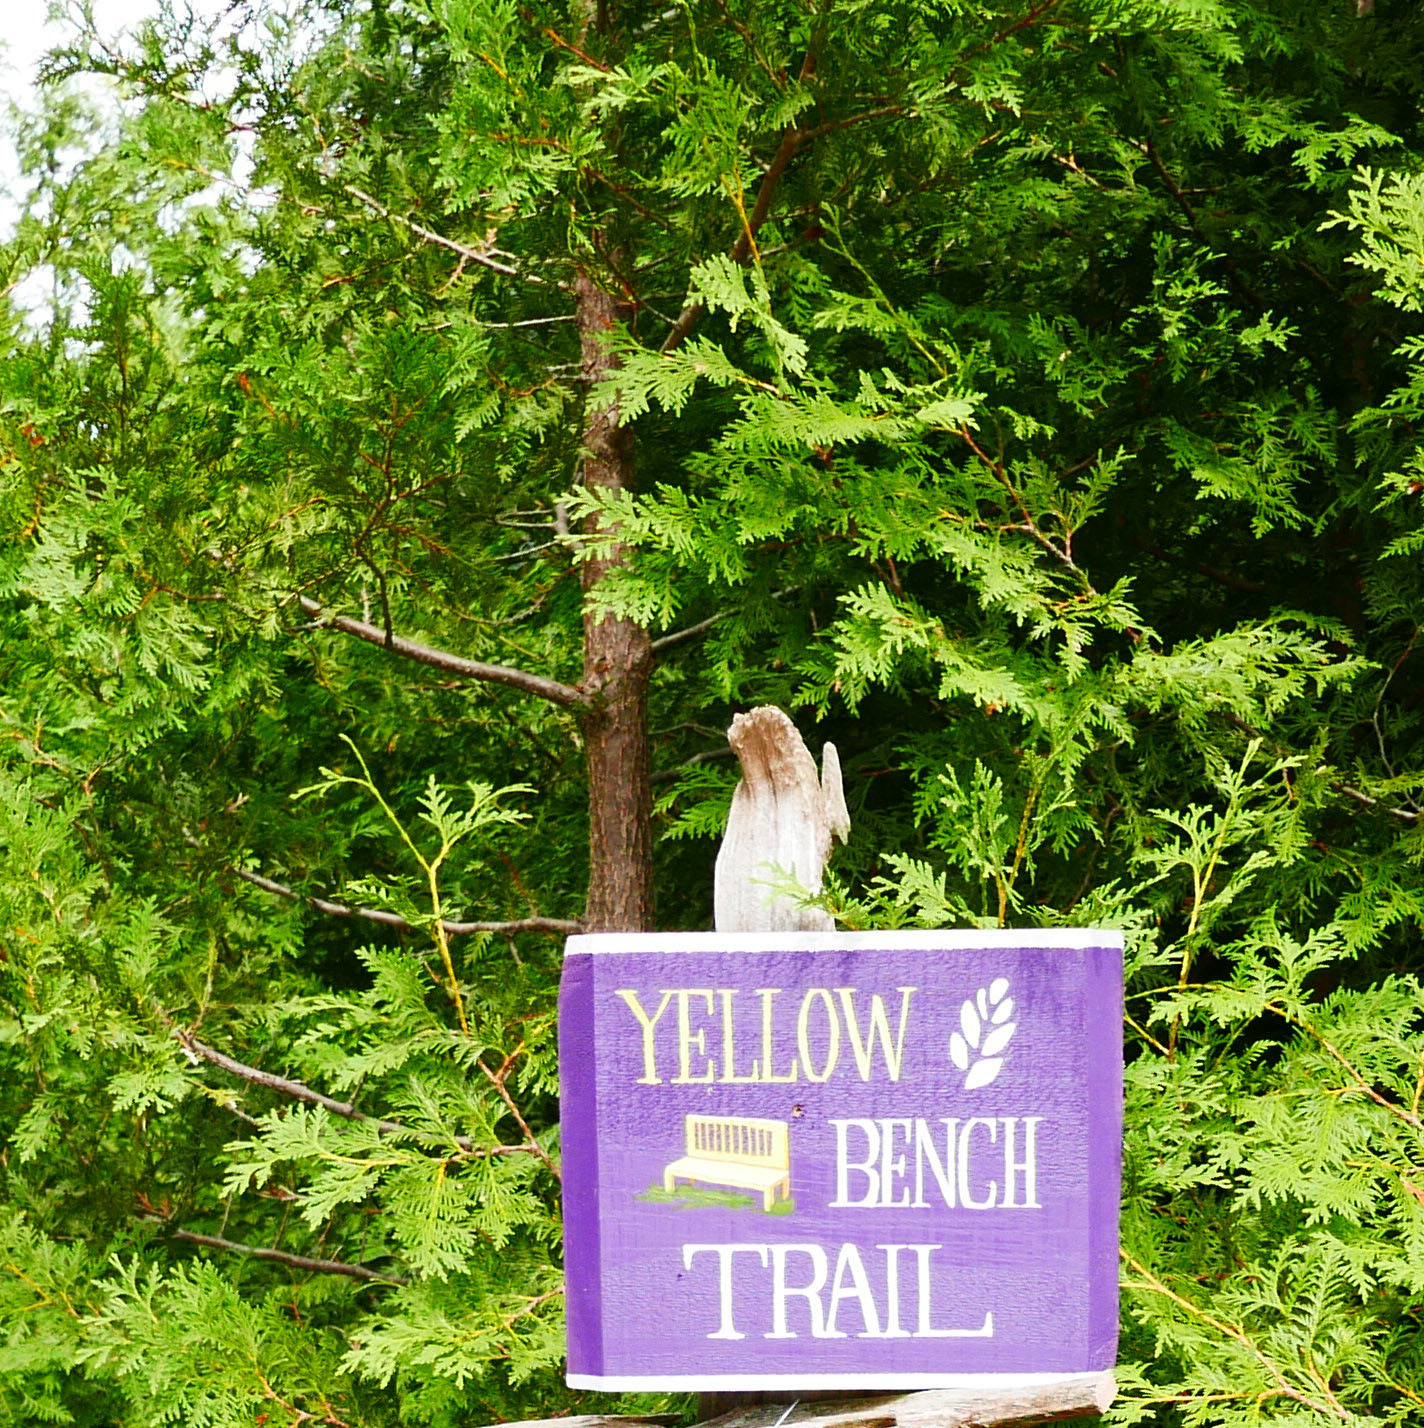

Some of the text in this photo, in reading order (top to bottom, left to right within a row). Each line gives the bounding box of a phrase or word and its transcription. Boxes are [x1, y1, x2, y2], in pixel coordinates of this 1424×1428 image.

[614, 985, 917, 1086] YELLOW
[827, 1116, 1044, 1210] BENCH
[682, 1243, 994, 1340] TRAIL
